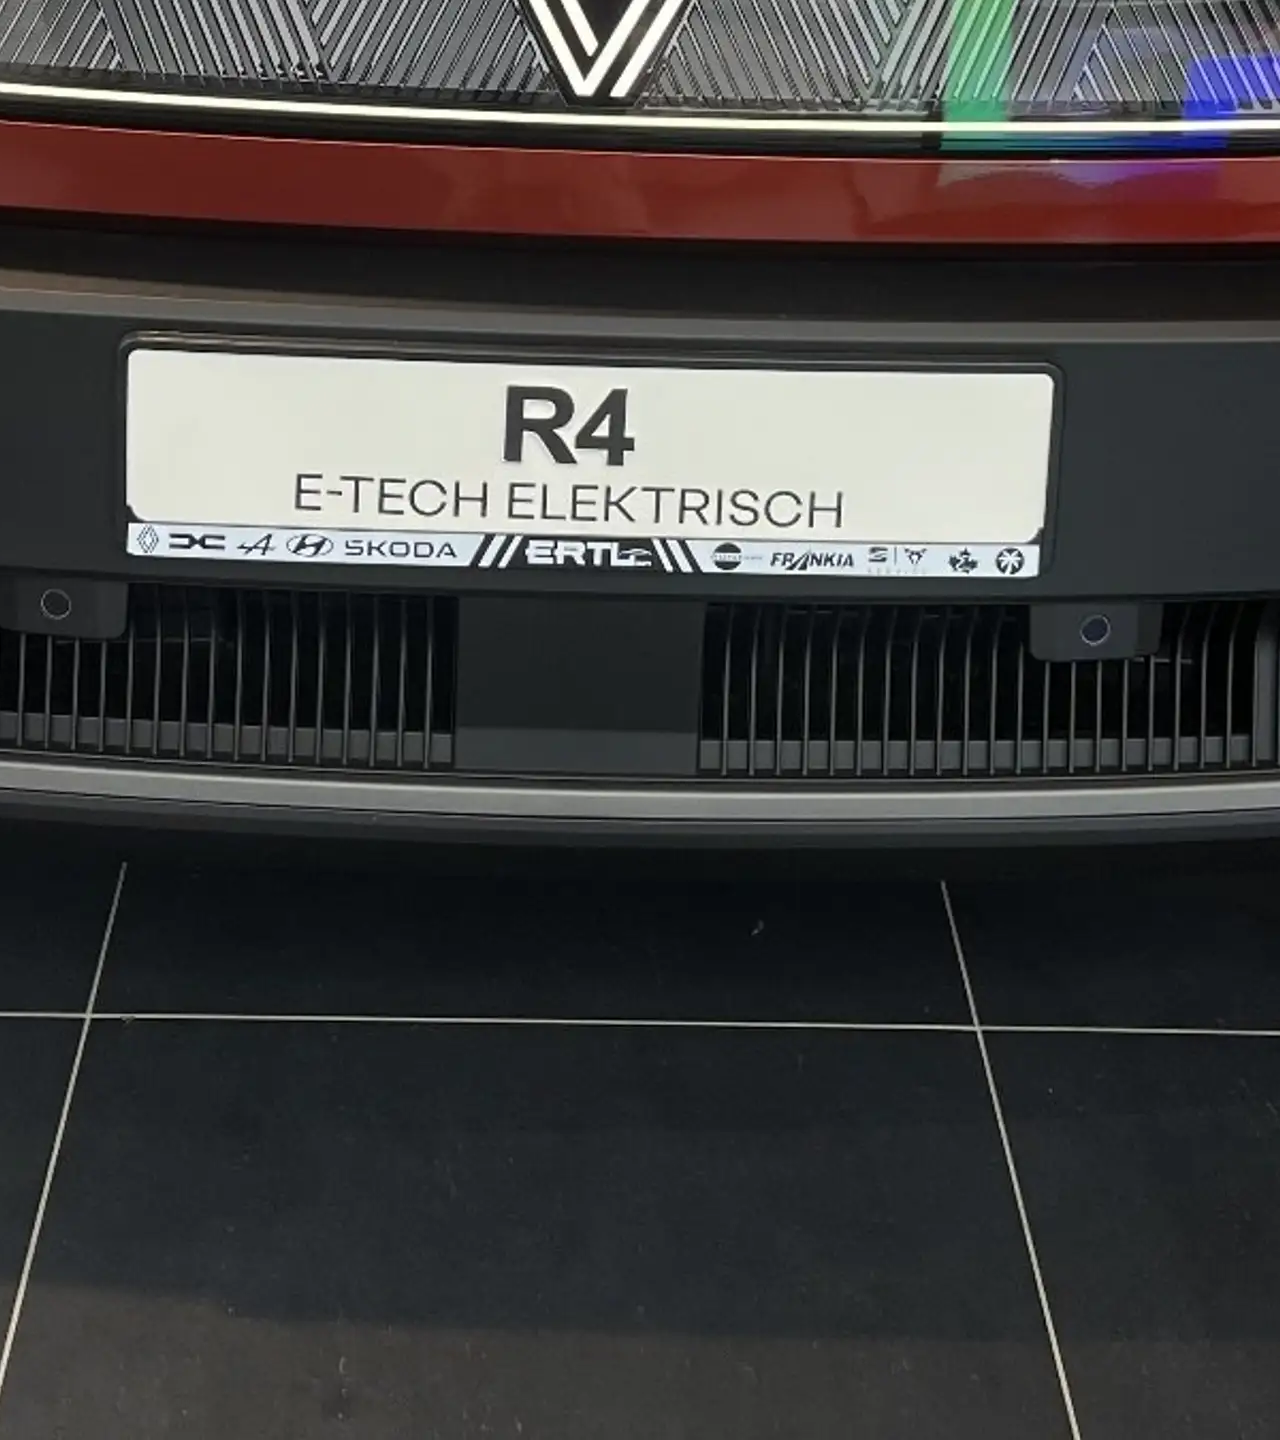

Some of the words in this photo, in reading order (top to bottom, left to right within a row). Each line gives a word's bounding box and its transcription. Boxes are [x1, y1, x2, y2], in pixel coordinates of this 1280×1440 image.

[502, 385, 635, 467] R4
[294, 473, 488, 518] E-TECH
[507, 482, 843, 528] ELEKTRISCH
[524, 539, 640, 567] ERTL
[770, 551, 854, 571] FRANKIA
